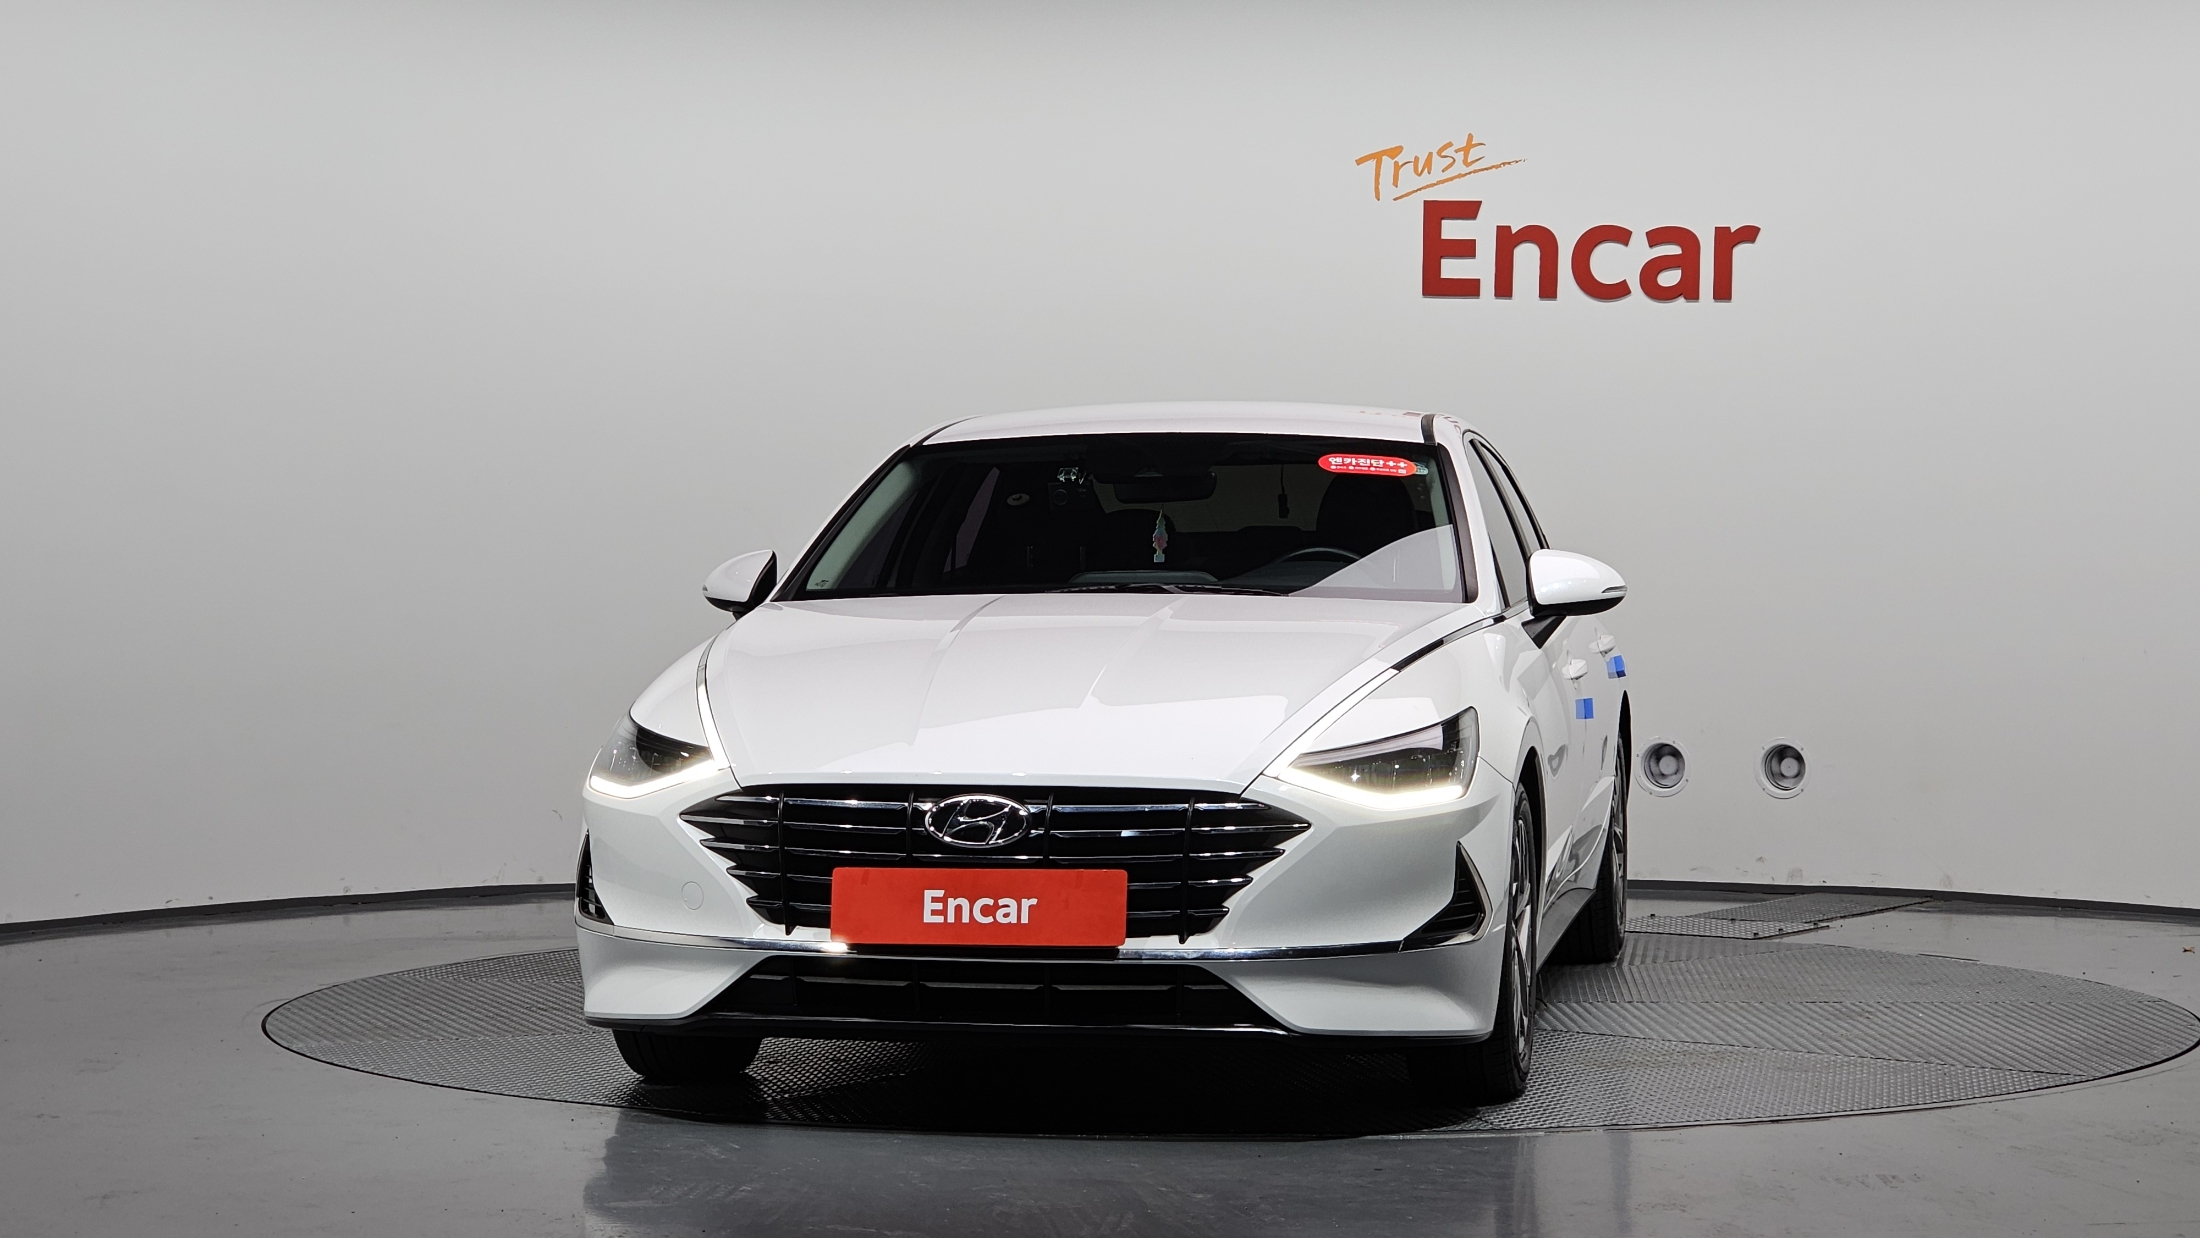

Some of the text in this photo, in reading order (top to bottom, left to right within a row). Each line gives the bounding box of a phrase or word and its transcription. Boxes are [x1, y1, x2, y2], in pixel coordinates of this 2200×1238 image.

[1355, 132, 1487, 201] Trust
[1421, 199, 1761, 303] Encar
[923, 889, 1038, 925] Encar
